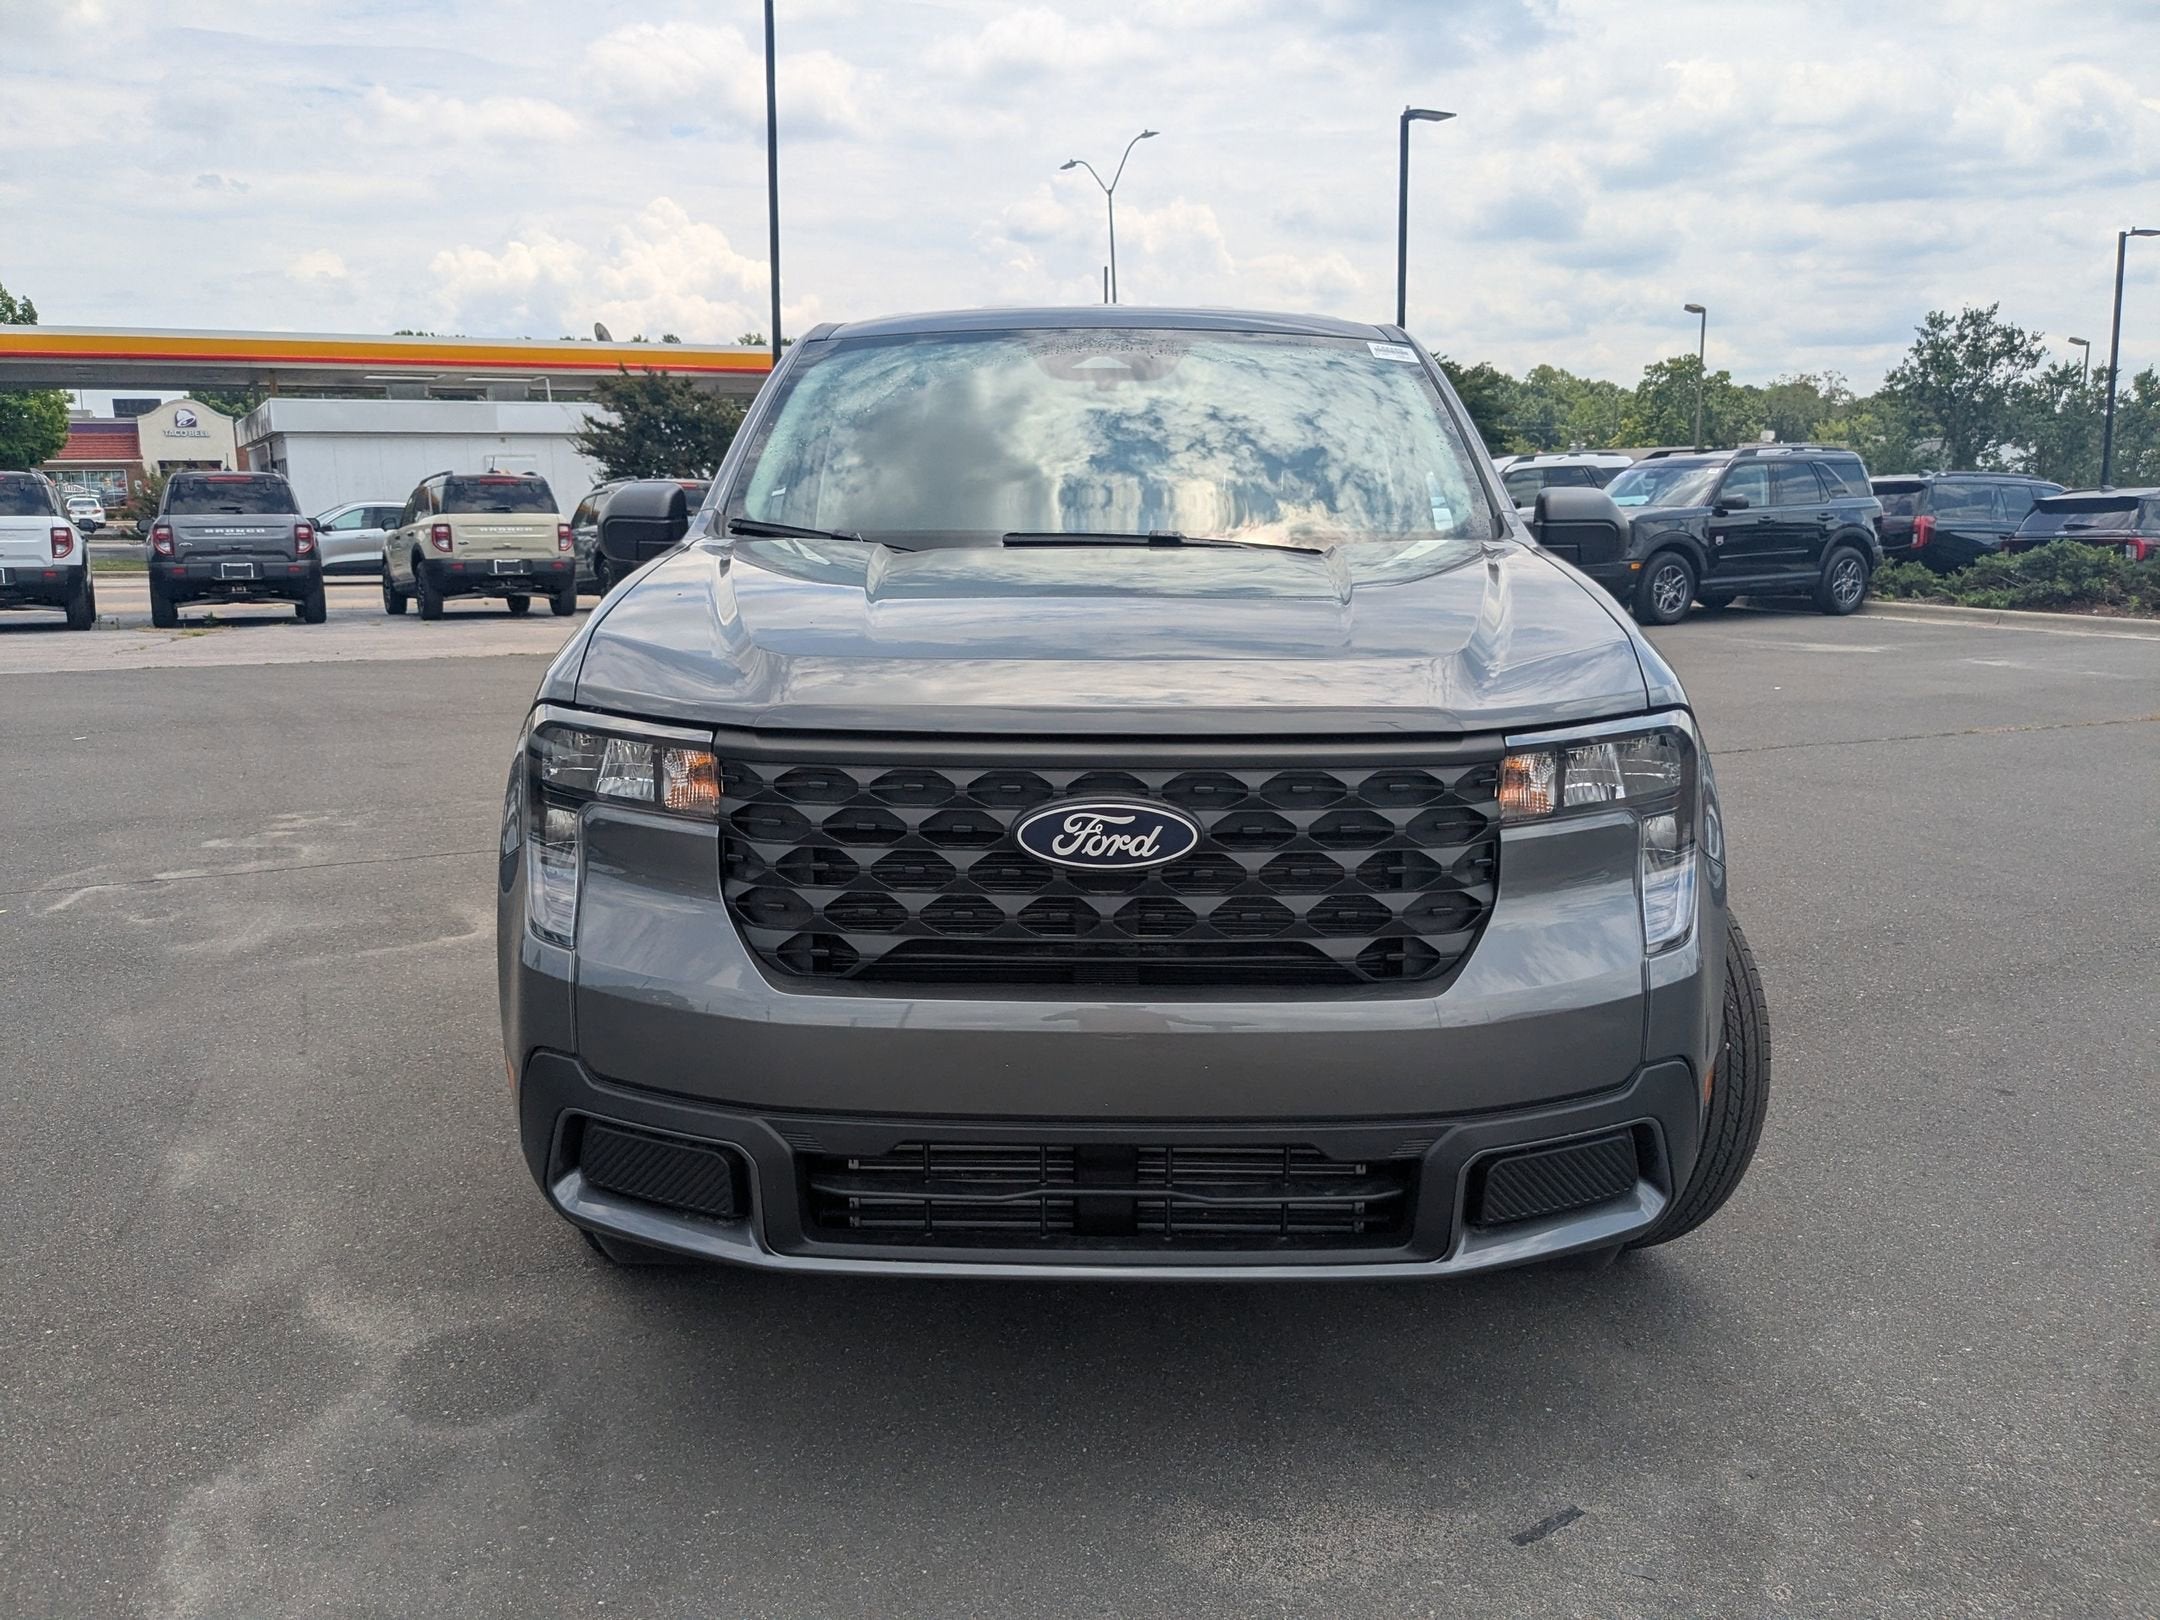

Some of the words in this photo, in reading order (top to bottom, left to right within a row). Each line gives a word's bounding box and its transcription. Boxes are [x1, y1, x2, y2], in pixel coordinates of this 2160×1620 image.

[163, 430, 188, 438] TACO
[189, 430, 210, 438] BELL
[1052, 812, 1163, 858] Ford
